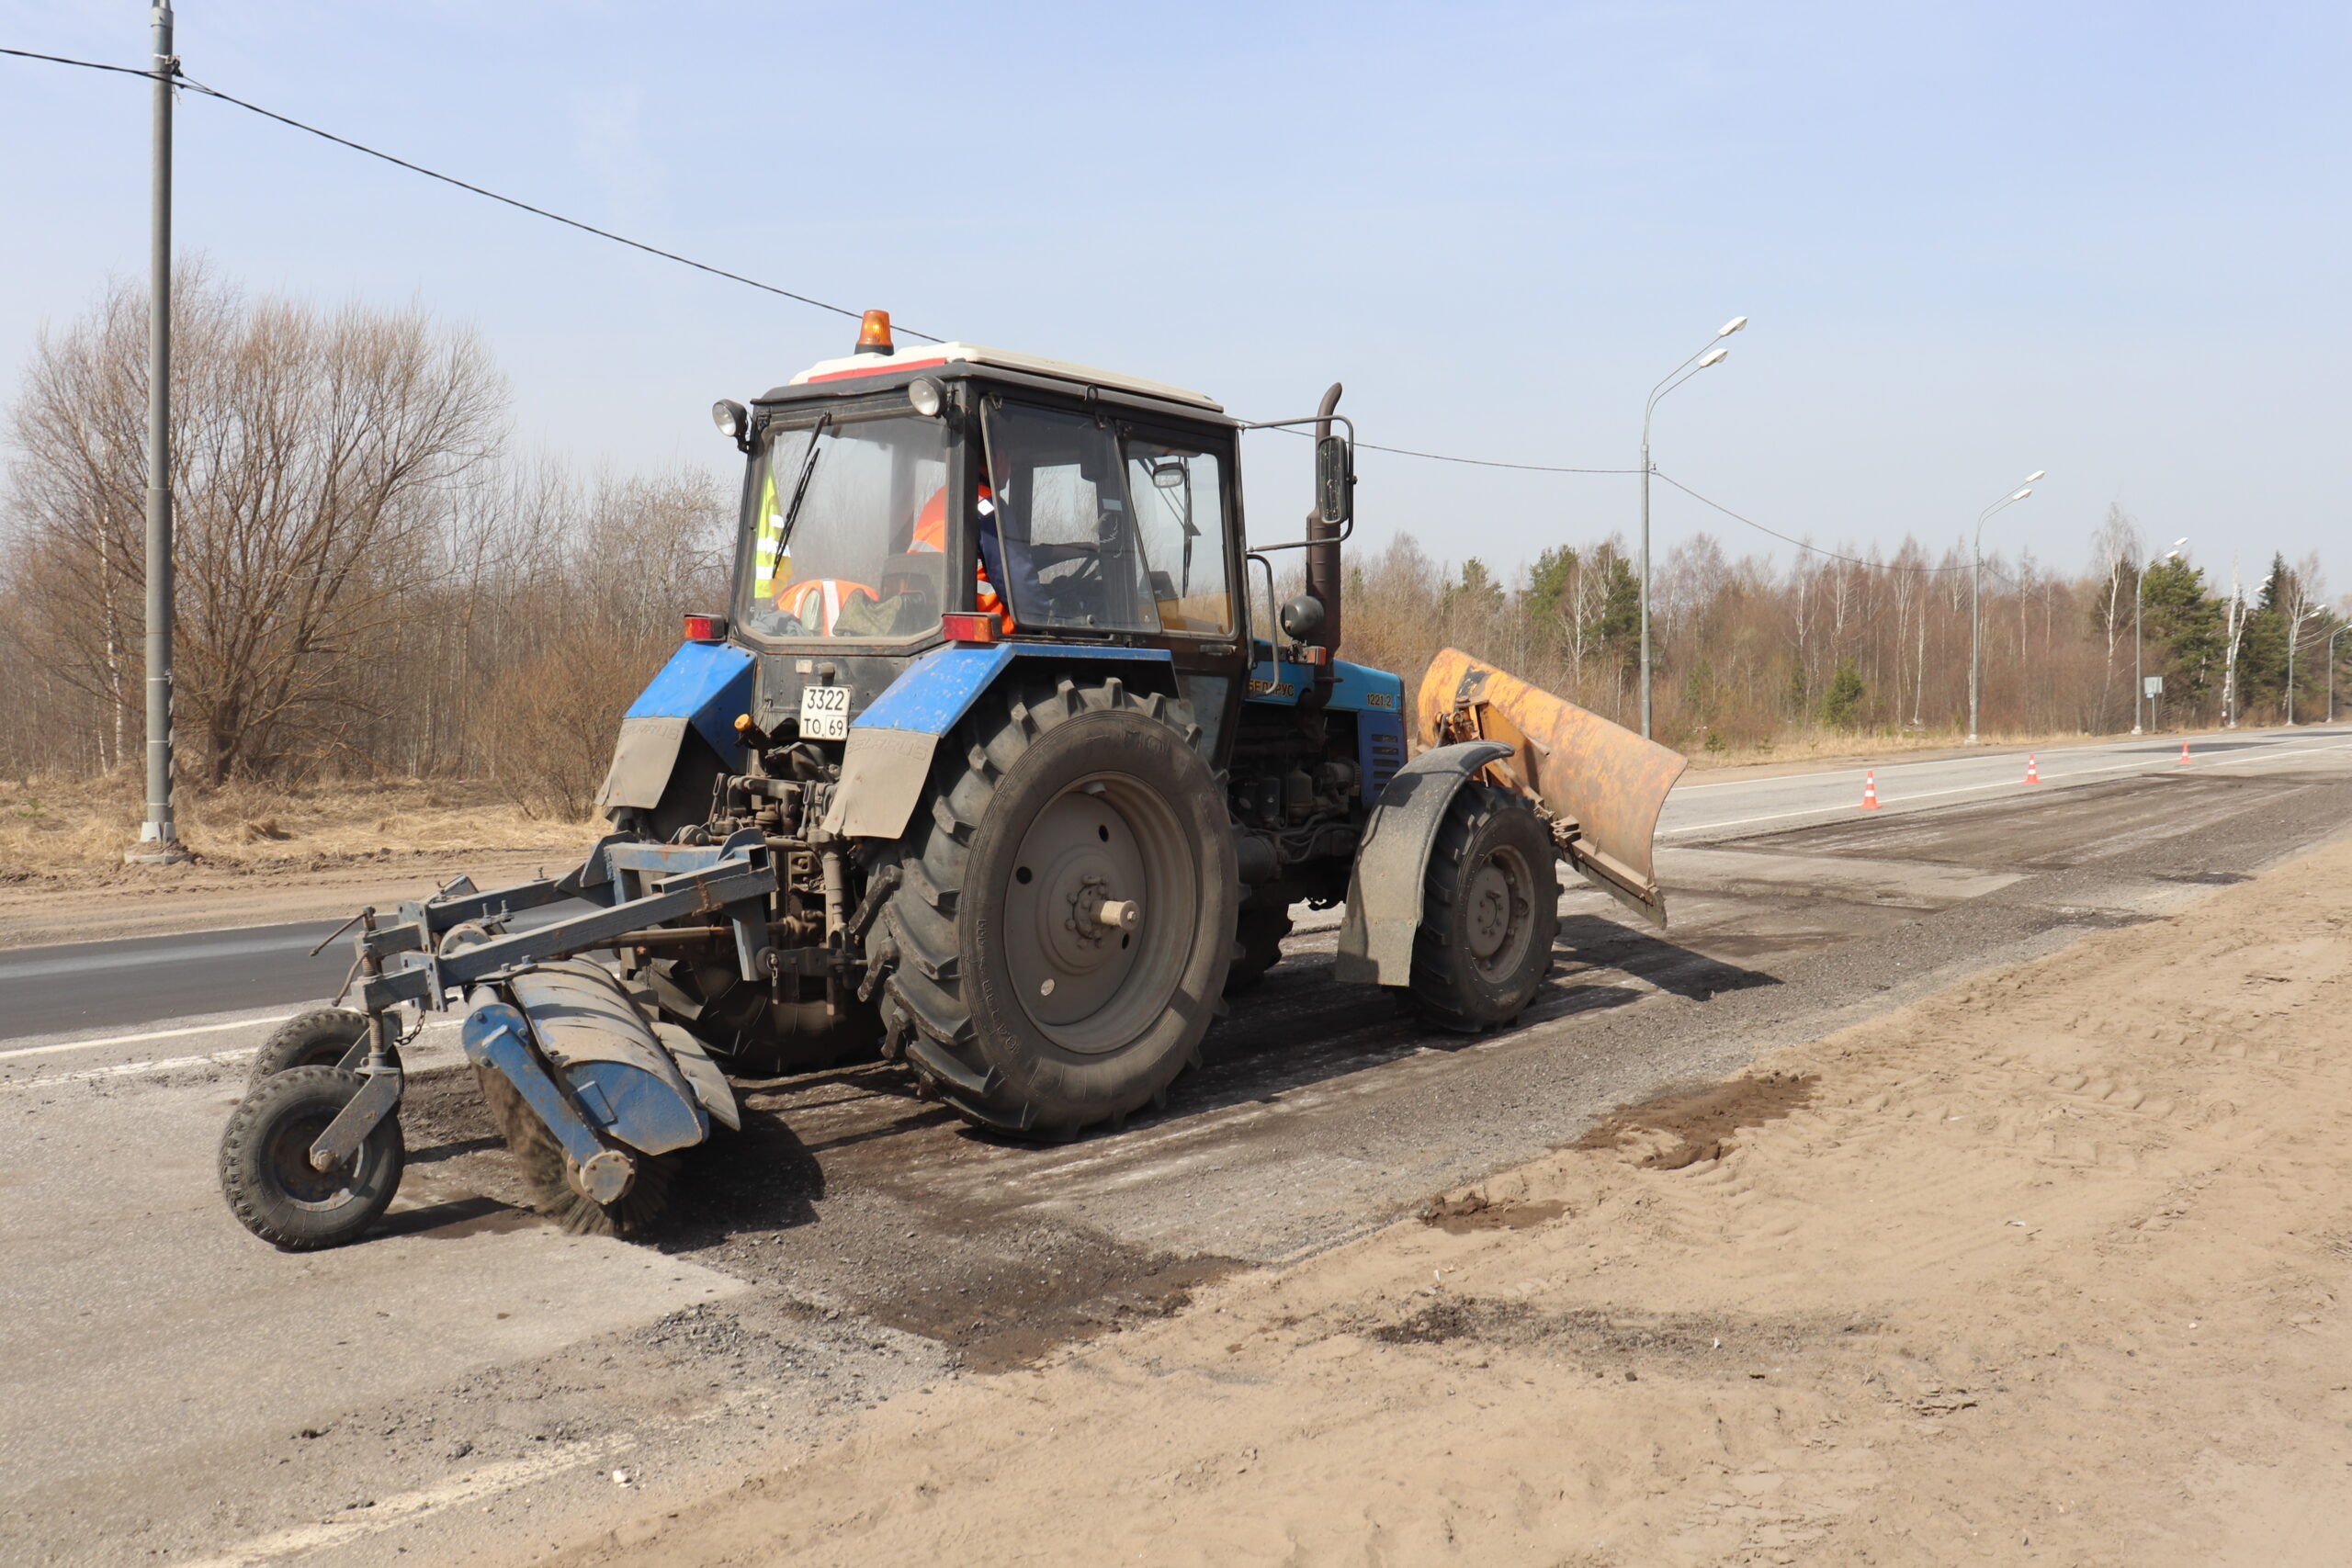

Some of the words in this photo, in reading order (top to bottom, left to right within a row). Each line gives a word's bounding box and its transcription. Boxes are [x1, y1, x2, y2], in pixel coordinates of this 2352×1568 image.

[807, 689, 844, 711] 3322
[1367, 694, 1392, 706] 1221.2
[804, 717, 821, 735] ТО
[829, 719, 843, 737] 69
